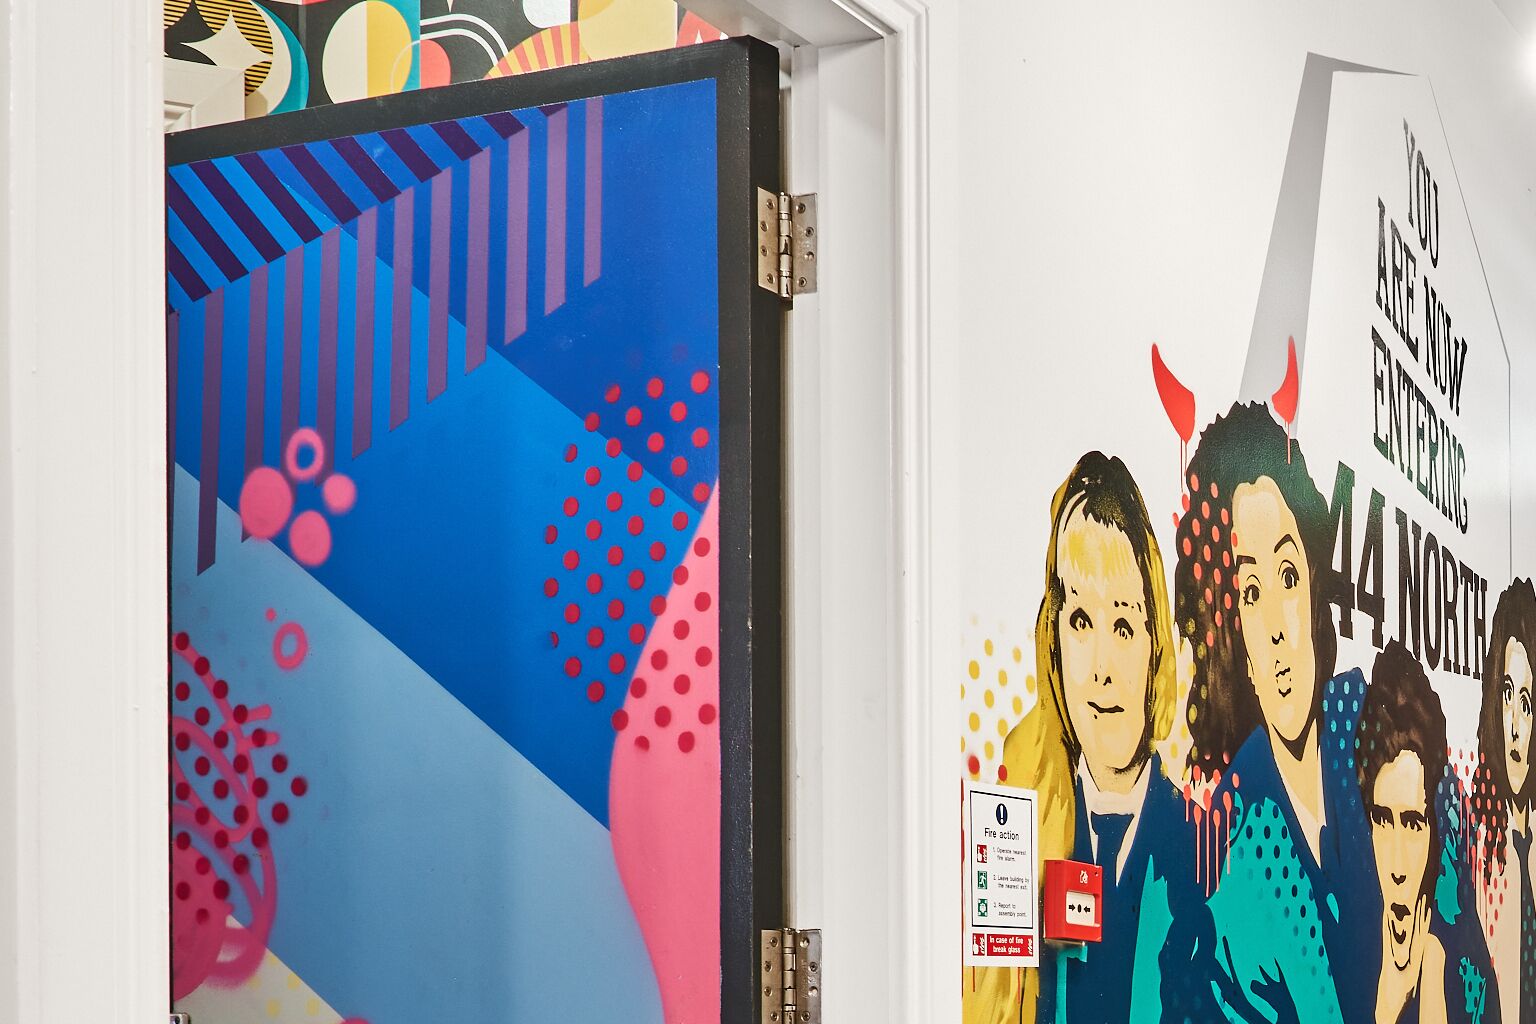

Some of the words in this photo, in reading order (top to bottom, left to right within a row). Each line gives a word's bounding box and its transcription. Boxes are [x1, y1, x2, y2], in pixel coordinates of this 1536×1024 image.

[1403, 117, 1439, 269] YOU
[1376, 195, 1419, 363] ARE
[1423, 275, 1468, 417] NOW
[1371, 324, 1468, 534] ENTERING
[1322, 460, 1386, 652] 44
[1395, 506, 1488, 680] NORTH
[984, 827, 997, 839] Fire
[1000, 830, 1020, 841] action
[1008, 947, 1020, 955] glass
